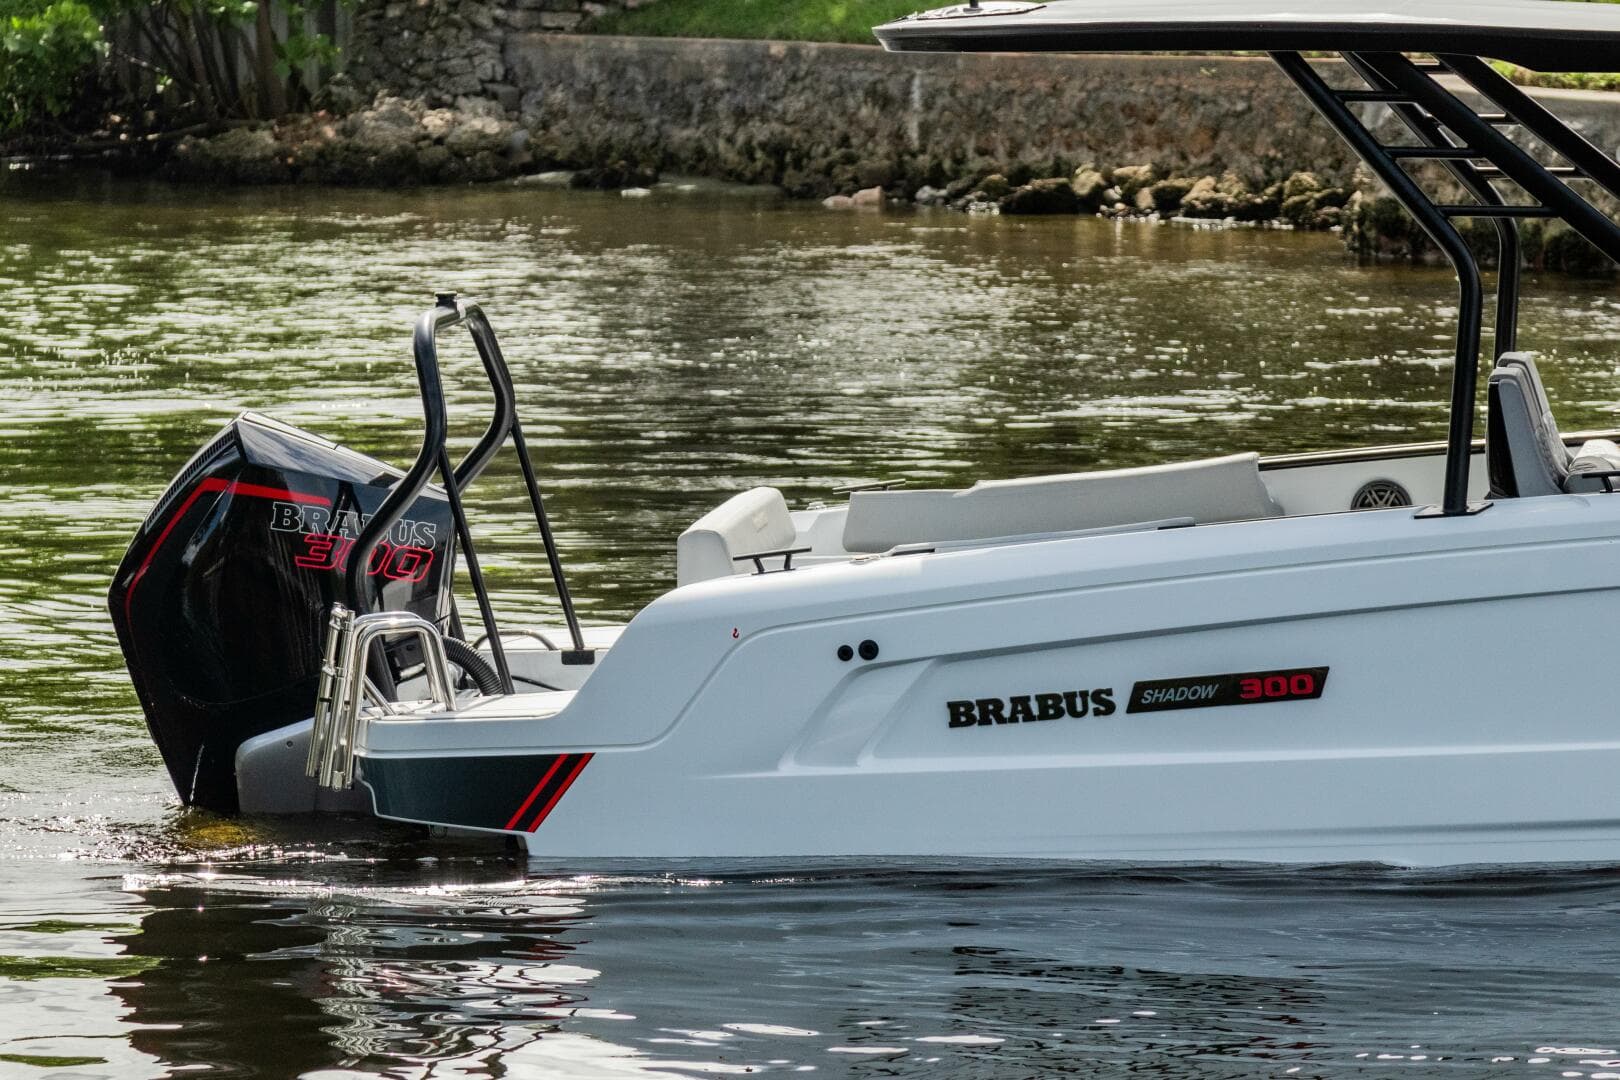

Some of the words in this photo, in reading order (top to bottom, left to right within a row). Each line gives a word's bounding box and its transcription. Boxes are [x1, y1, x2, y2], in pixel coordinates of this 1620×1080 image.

[270, 501, 437, 551] BRAUS
[946, 687, 1117, 729] BRABUS
[1140, 683, 1220, 704] SHADOW
[1239, 673, 1314, 699] 300
